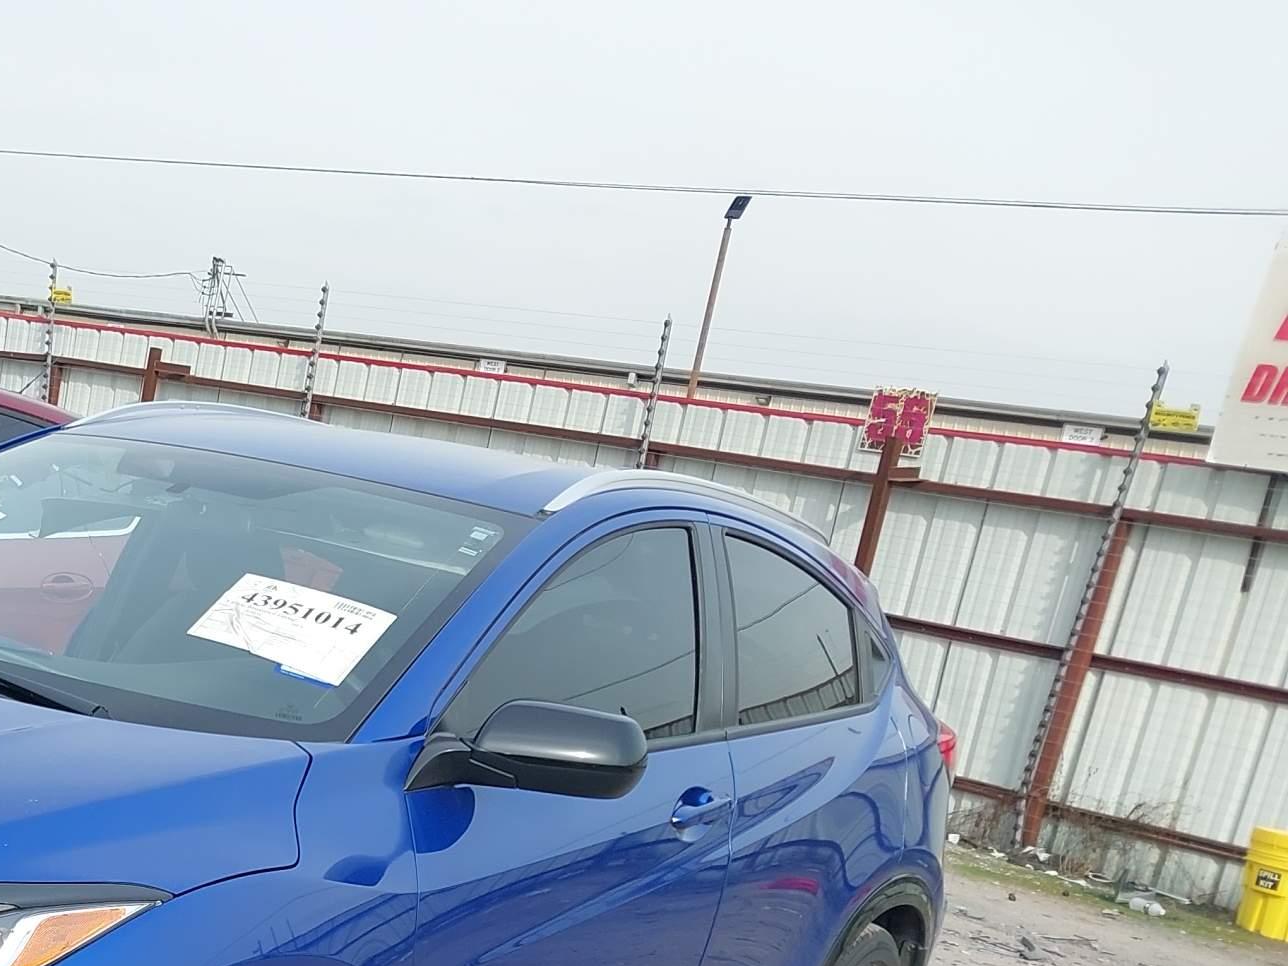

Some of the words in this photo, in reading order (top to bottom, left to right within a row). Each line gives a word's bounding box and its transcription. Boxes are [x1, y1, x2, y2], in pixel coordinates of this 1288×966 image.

[241, 592, 363, 635] 43951014
[1259, 870, 1280, 881] SPILL
[1259, 880, 1274, 889] KIT
